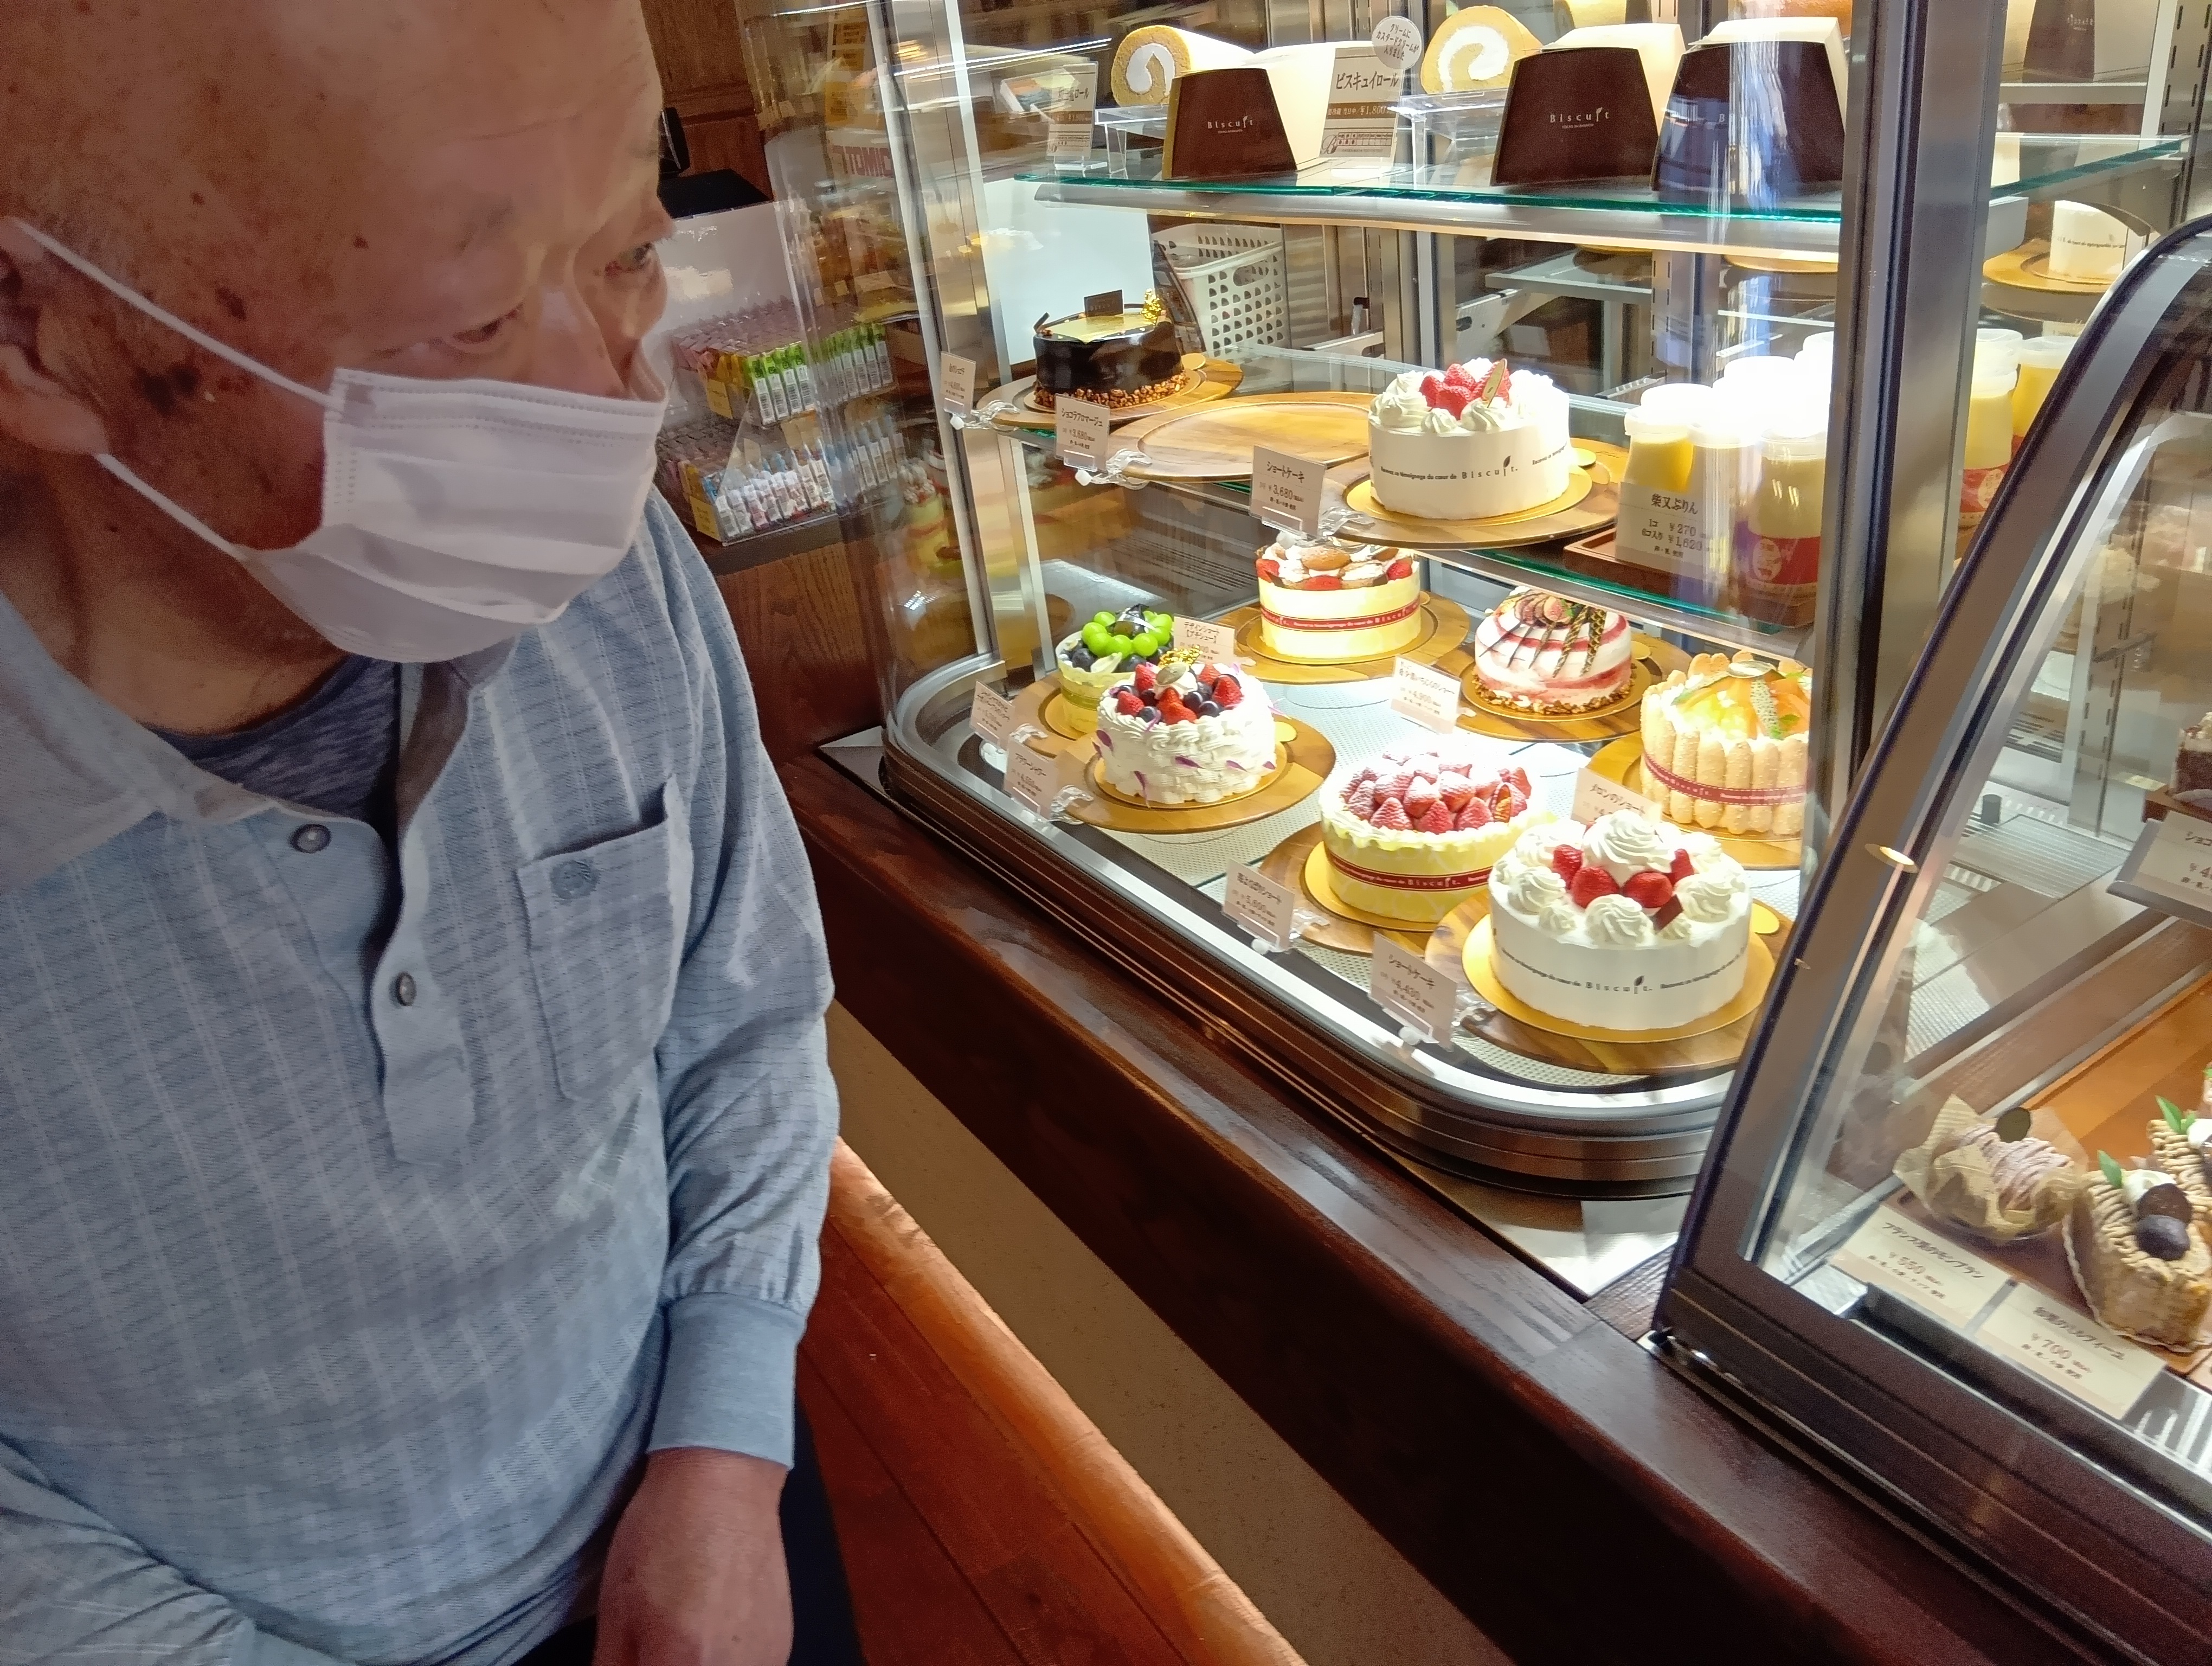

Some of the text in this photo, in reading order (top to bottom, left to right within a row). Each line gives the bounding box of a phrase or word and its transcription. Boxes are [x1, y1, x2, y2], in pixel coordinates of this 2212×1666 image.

[1390, 23, 1411, 39] クリームに
[1376, 30, 1419, 54] カスタードクリームが
[1384, 44, 1405, 61] 入りました
[1335, 71, 1400, 91] ビスキュイロール
[1551, 107, 1610, 123] Biscuit
[1267, 461, 1305, 483] ショートケーキ
[1651, 493, 1699, 515] 柴又ぷりん
[1669, 522, 1697, 537] ¥270
[1589, 784, 1645, 816] メロンのショート
[1388, 954, 1436, 990] ショートケーキ
